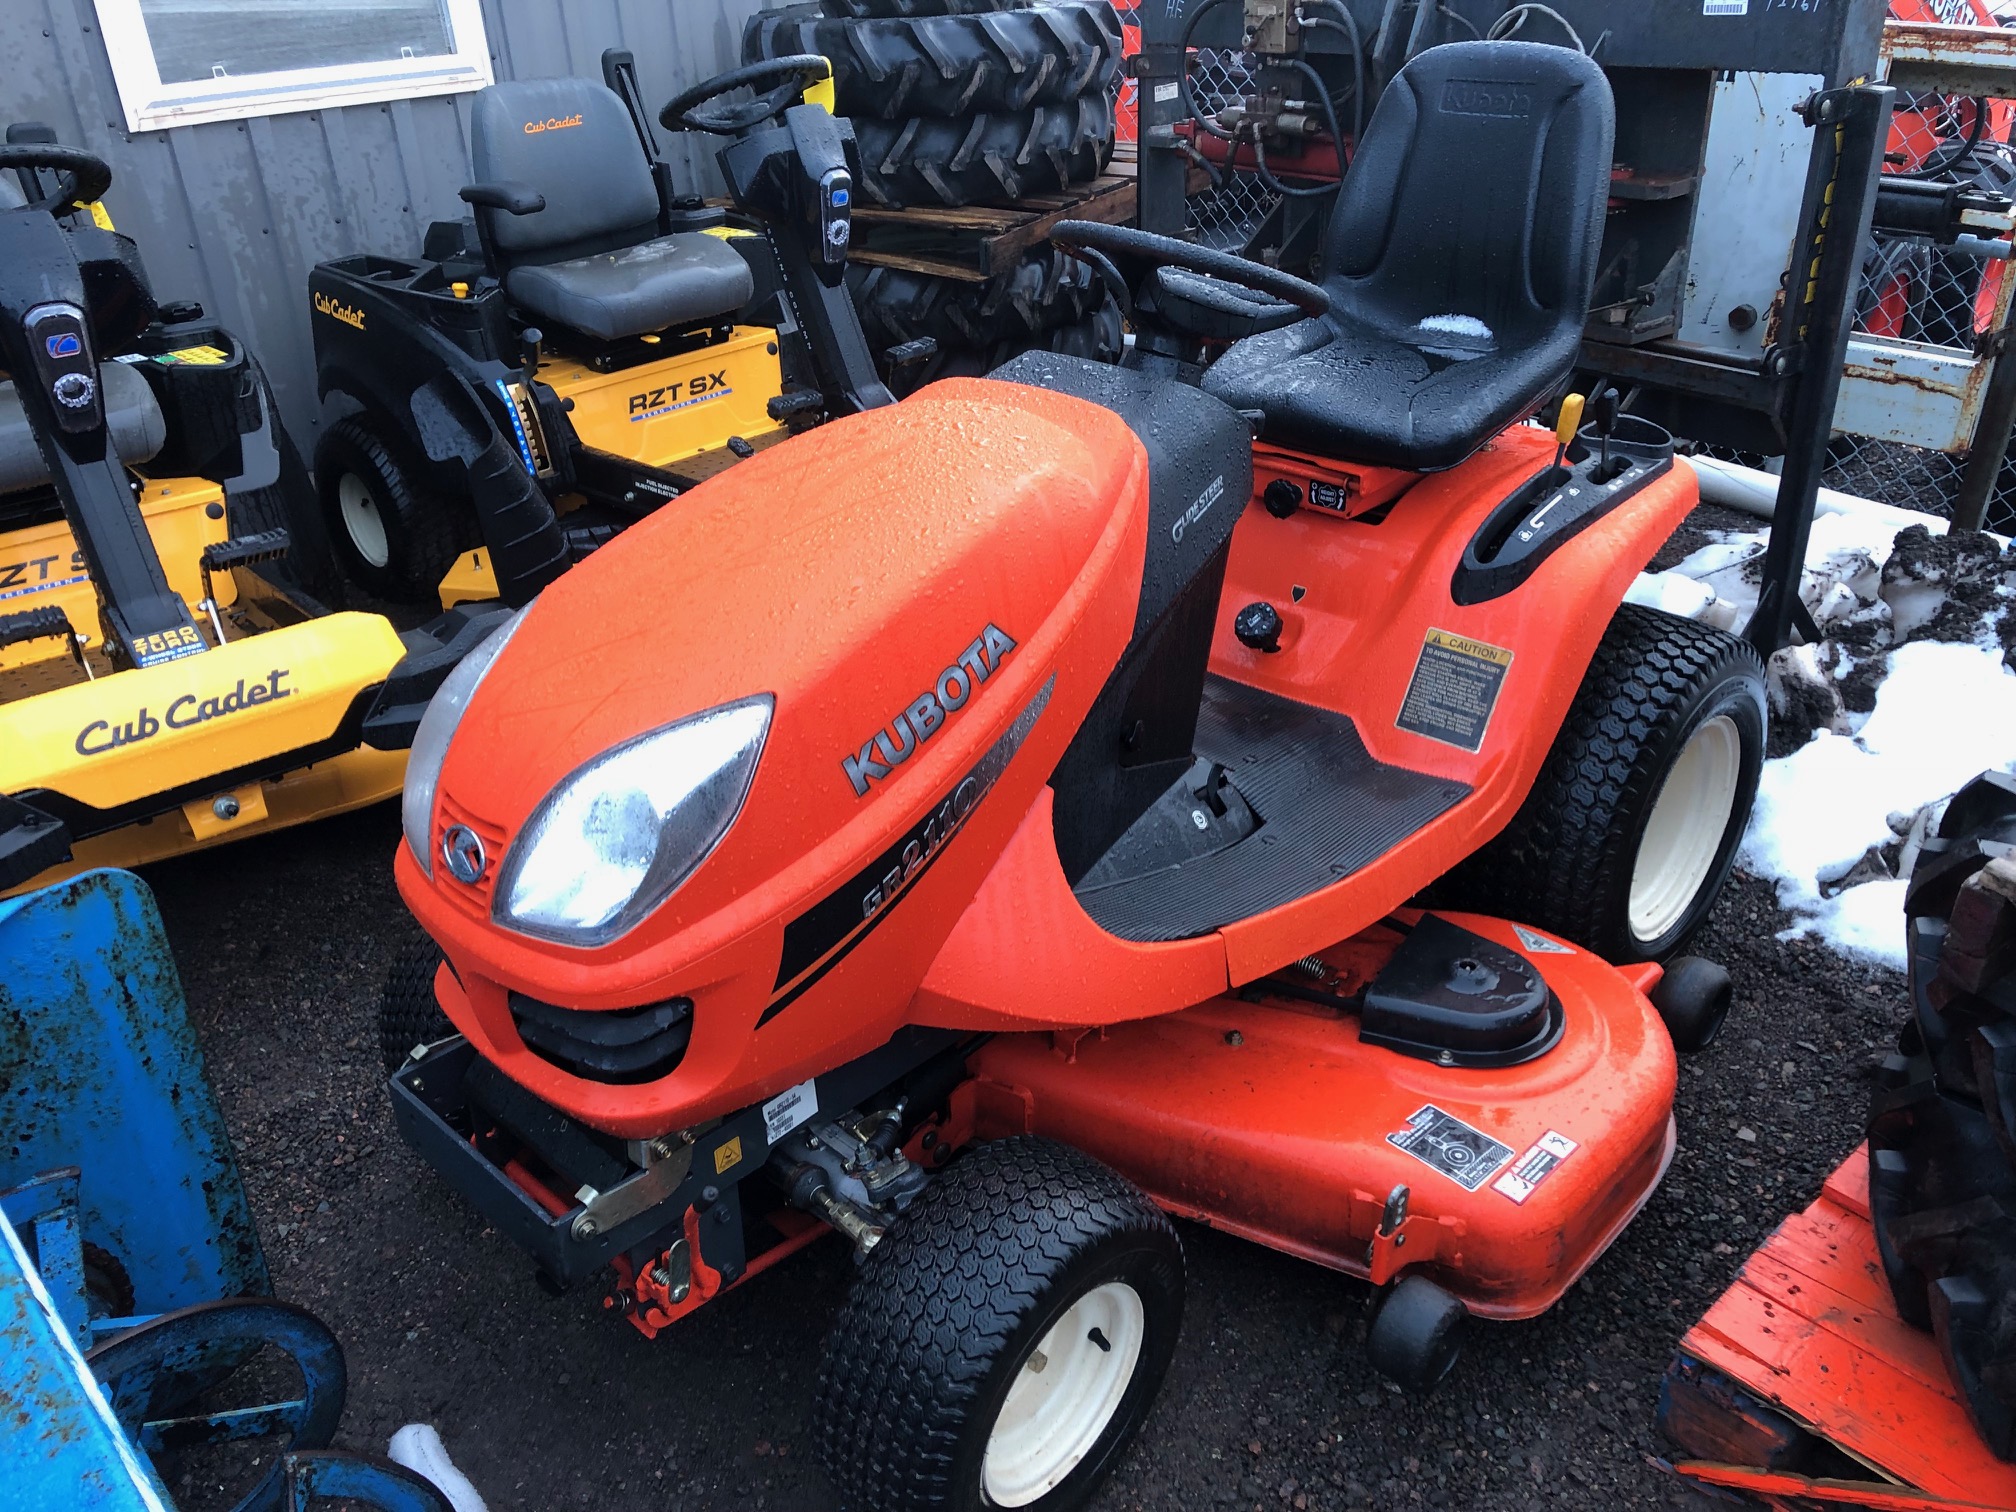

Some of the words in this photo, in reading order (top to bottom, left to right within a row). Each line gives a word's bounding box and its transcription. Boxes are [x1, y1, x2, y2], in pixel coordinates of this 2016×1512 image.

[524, 120, 546, 134] Cub
[546, 114, 583, 130] Cadet
[314, 291, 331, 315] Cub
[331, 298, 366, 330] Cadet
[629, 382, 683, 414] RZT
[689, 369, 727, 396] SX
[132, 626, 194, 648] ZERO
[135, 633, 199, 656] TURN
[1449, 638, 1498, 660] CAUTION
[1426, 646, 1434, 655] TO
[1433, 648, 1451, 660] AVOID
[1450, 651, 1480, 669] PERSONAL
[1480, 662, 1501, 674] INJURY
[75, 707, 160, 756] Cub
[165, 669, 291, 729] Cadet
[841, 621, 1019, 797] KUBOTA
[862, 776, 978, 919] GR2110
